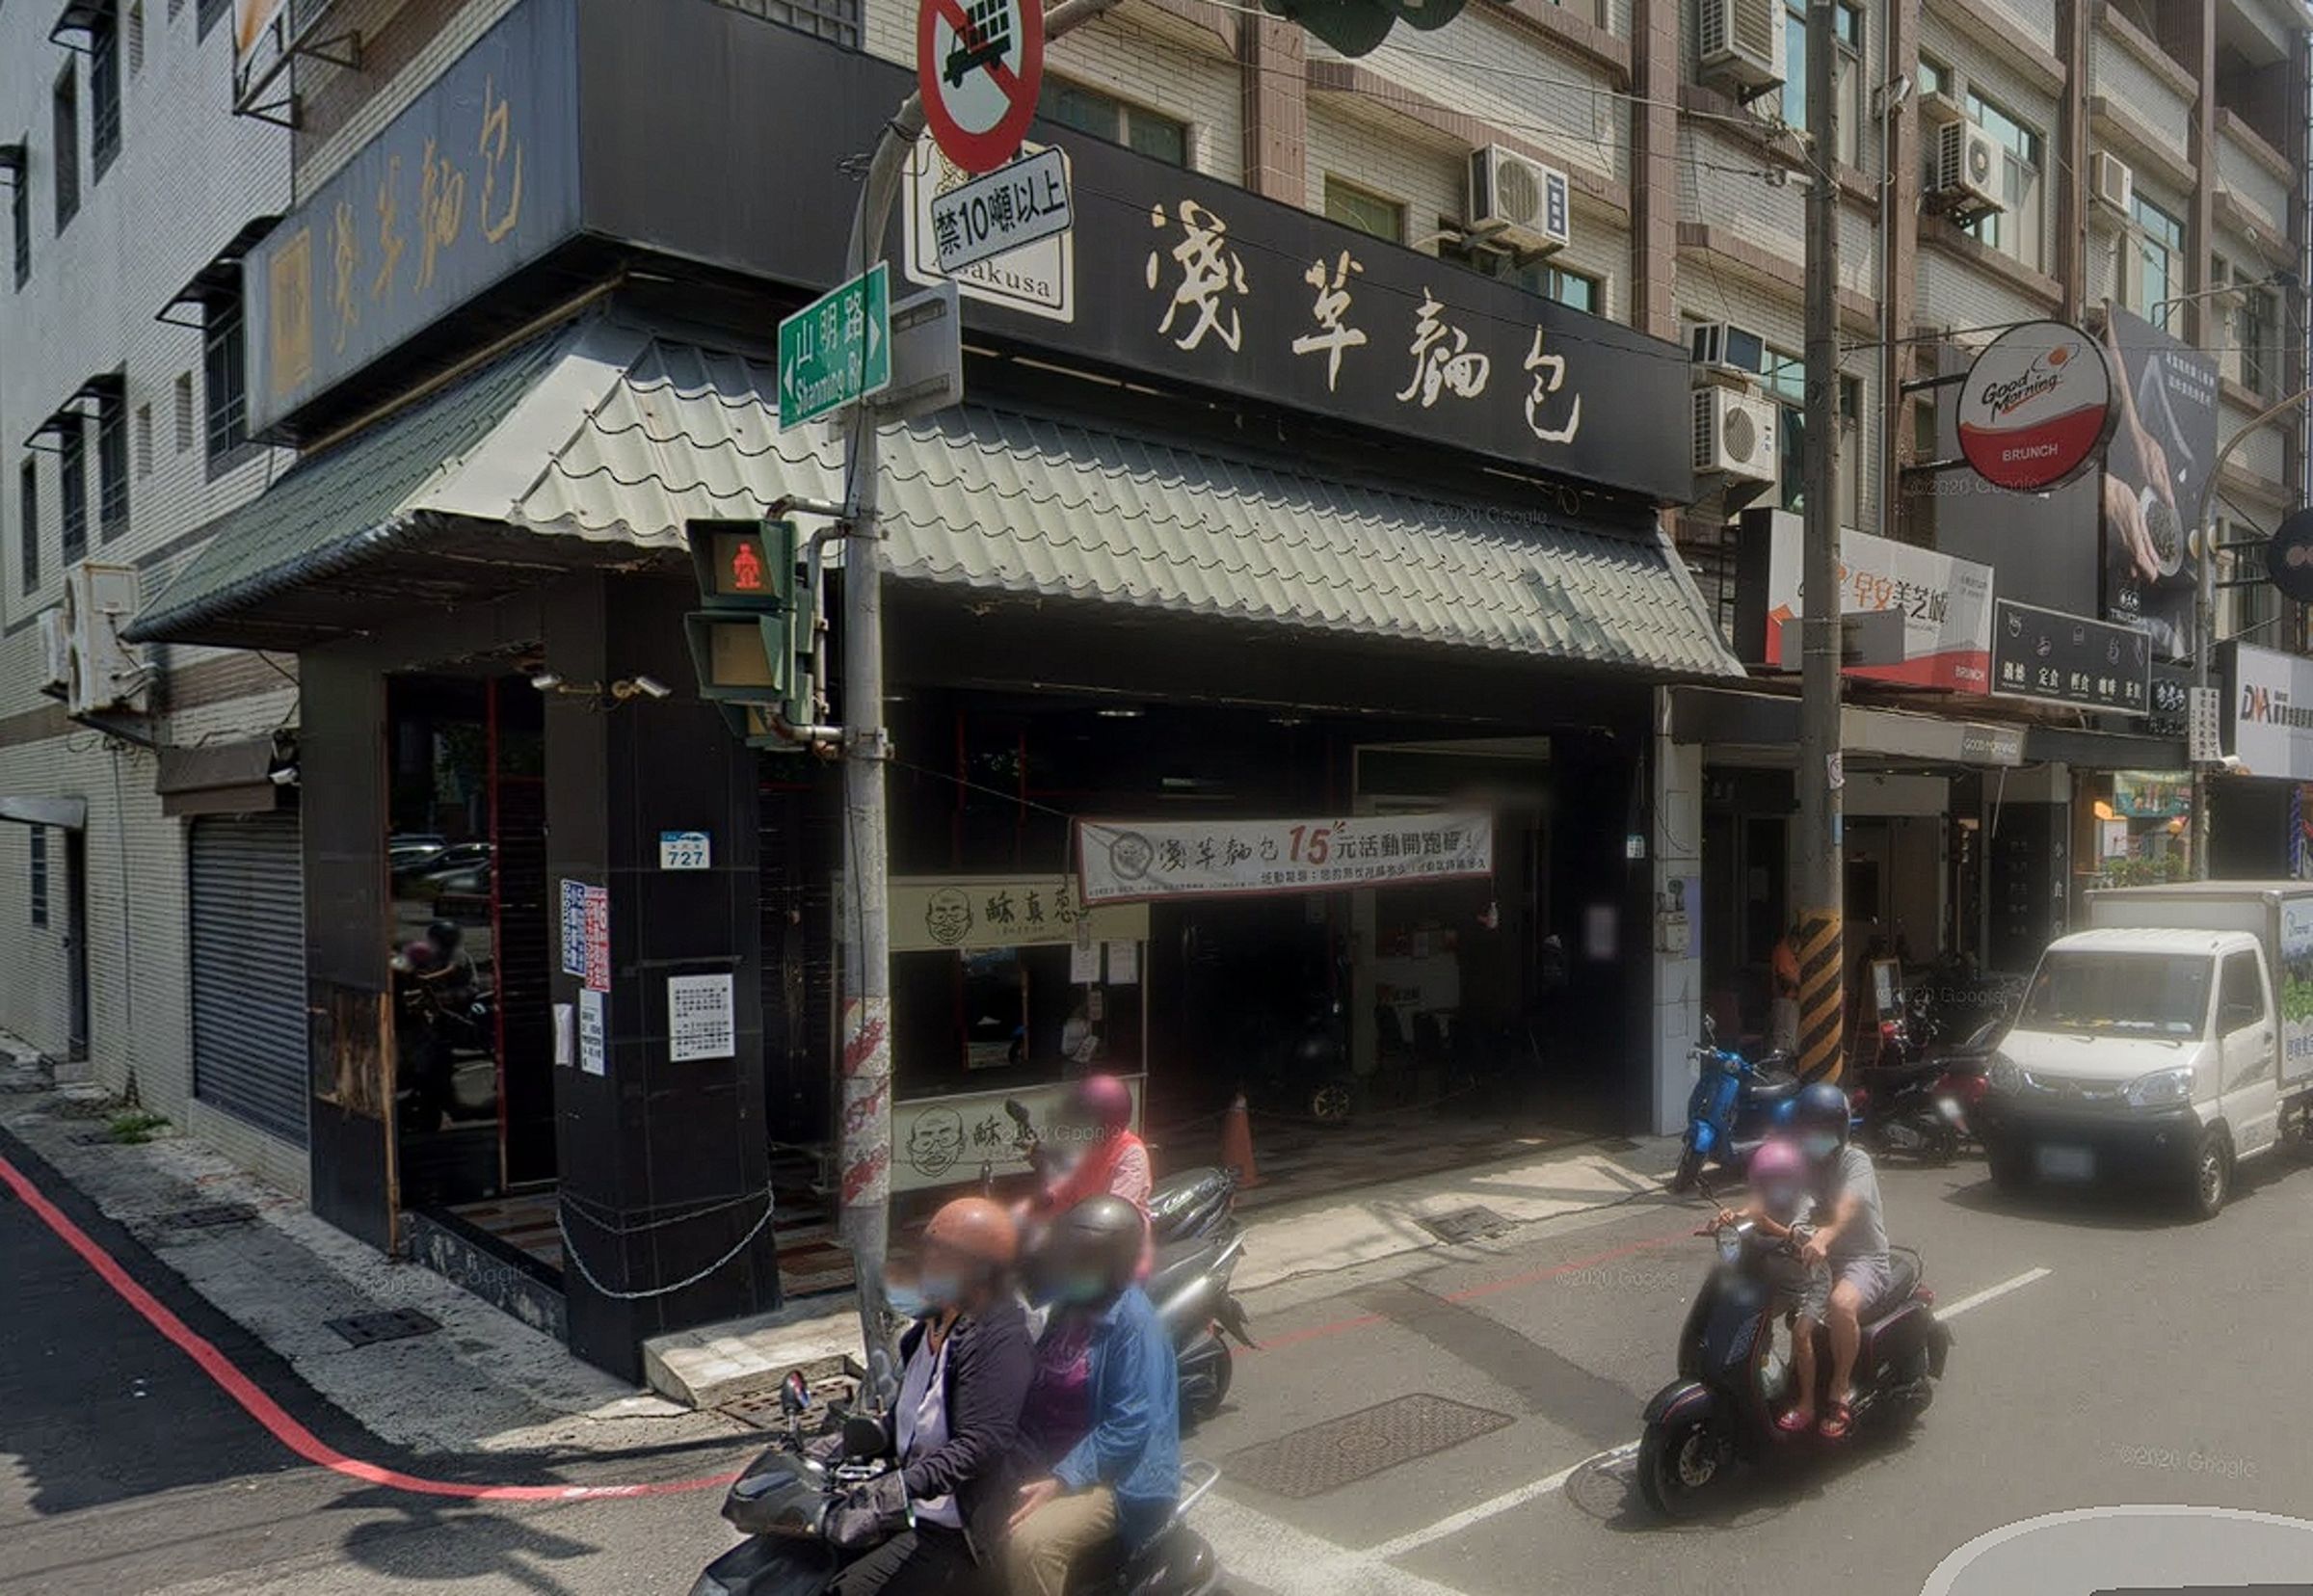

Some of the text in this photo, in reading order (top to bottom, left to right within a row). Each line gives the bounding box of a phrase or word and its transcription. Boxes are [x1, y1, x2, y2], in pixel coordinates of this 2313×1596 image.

[937, 170, 1065, 255] 禁10噸以上
[932, 256, 1051, 299] akusa
[796, 289, 864, 370] 山明路
[1146, 200, 1581, 444] 淺草麵包
[1981, 368, 2030, 406] Good
[1991, 374, 2059, 424] Morning
[2002, 443, 2059, 462] BRUNCH
[668, 851, 704, 866] 727
